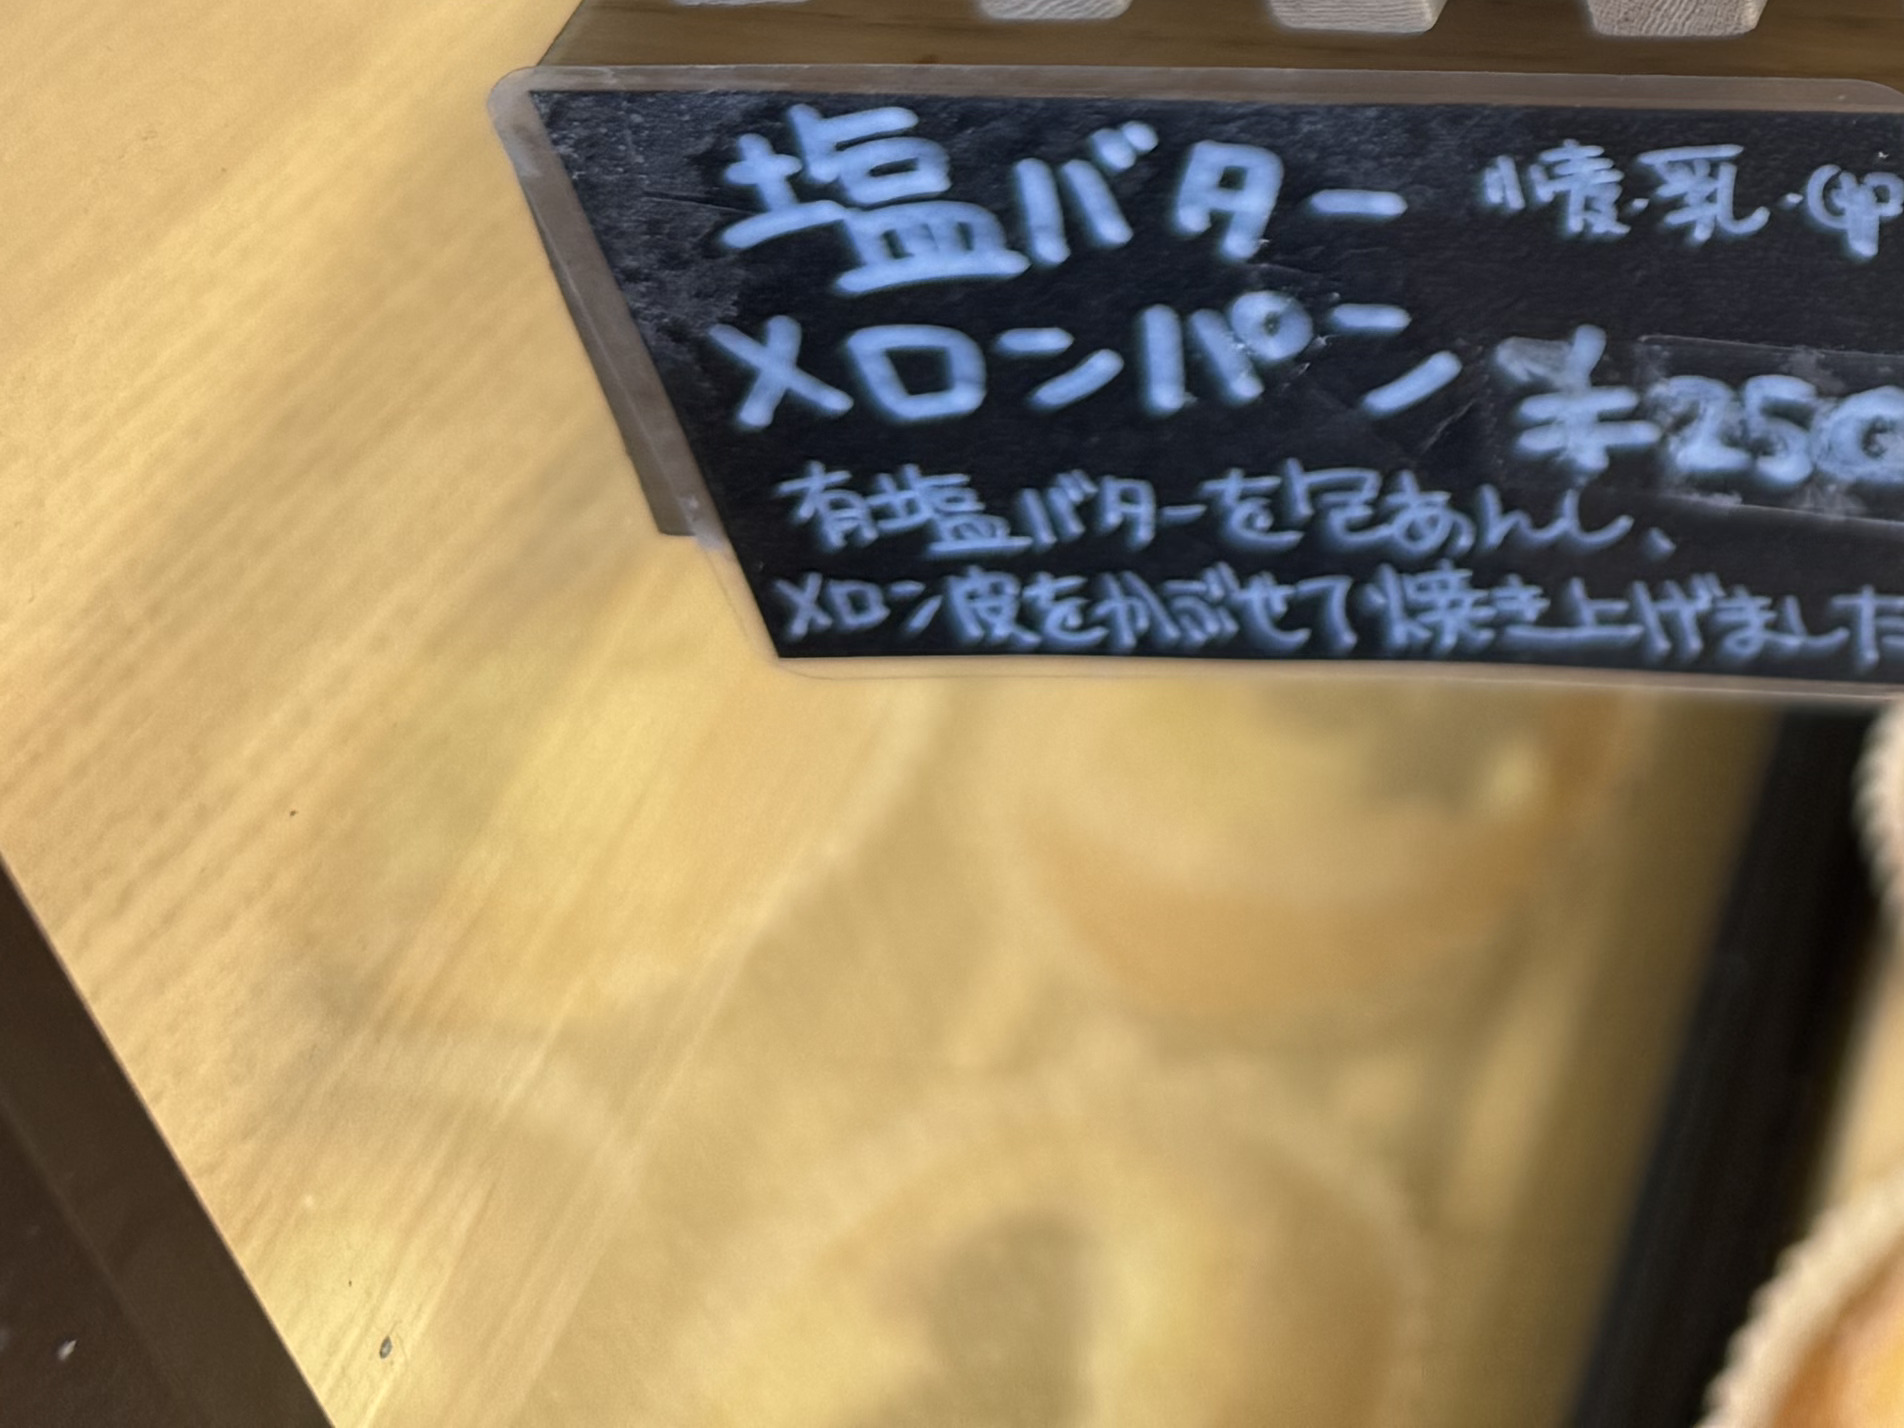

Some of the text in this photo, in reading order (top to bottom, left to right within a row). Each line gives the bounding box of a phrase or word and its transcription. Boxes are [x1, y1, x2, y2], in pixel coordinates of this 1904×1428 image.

[718, 103, 1408, 296] 塩バター
[708, 290, 1464, 429] メロンパン
